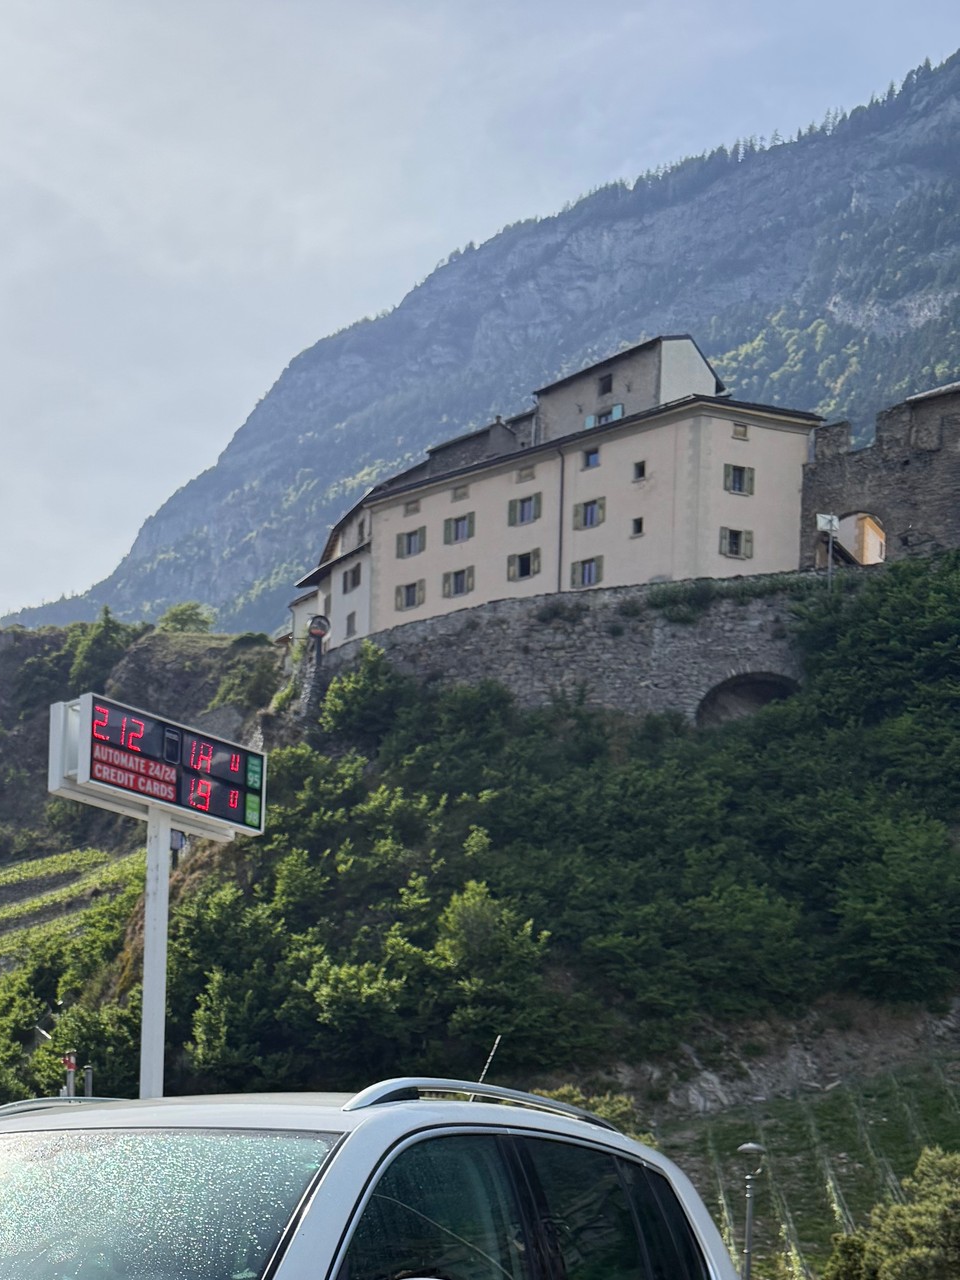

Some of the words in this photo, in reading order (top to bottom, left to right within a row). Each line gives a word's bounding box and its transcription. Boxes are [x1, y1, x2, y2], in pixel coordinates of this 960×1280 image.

[94, 745, 146, 773] AUTOMATE
[148, 762, 177, 783] 24/24
[95, 763, 136, 788] CREDIT
[138, 777, 175, 800] CARDS
